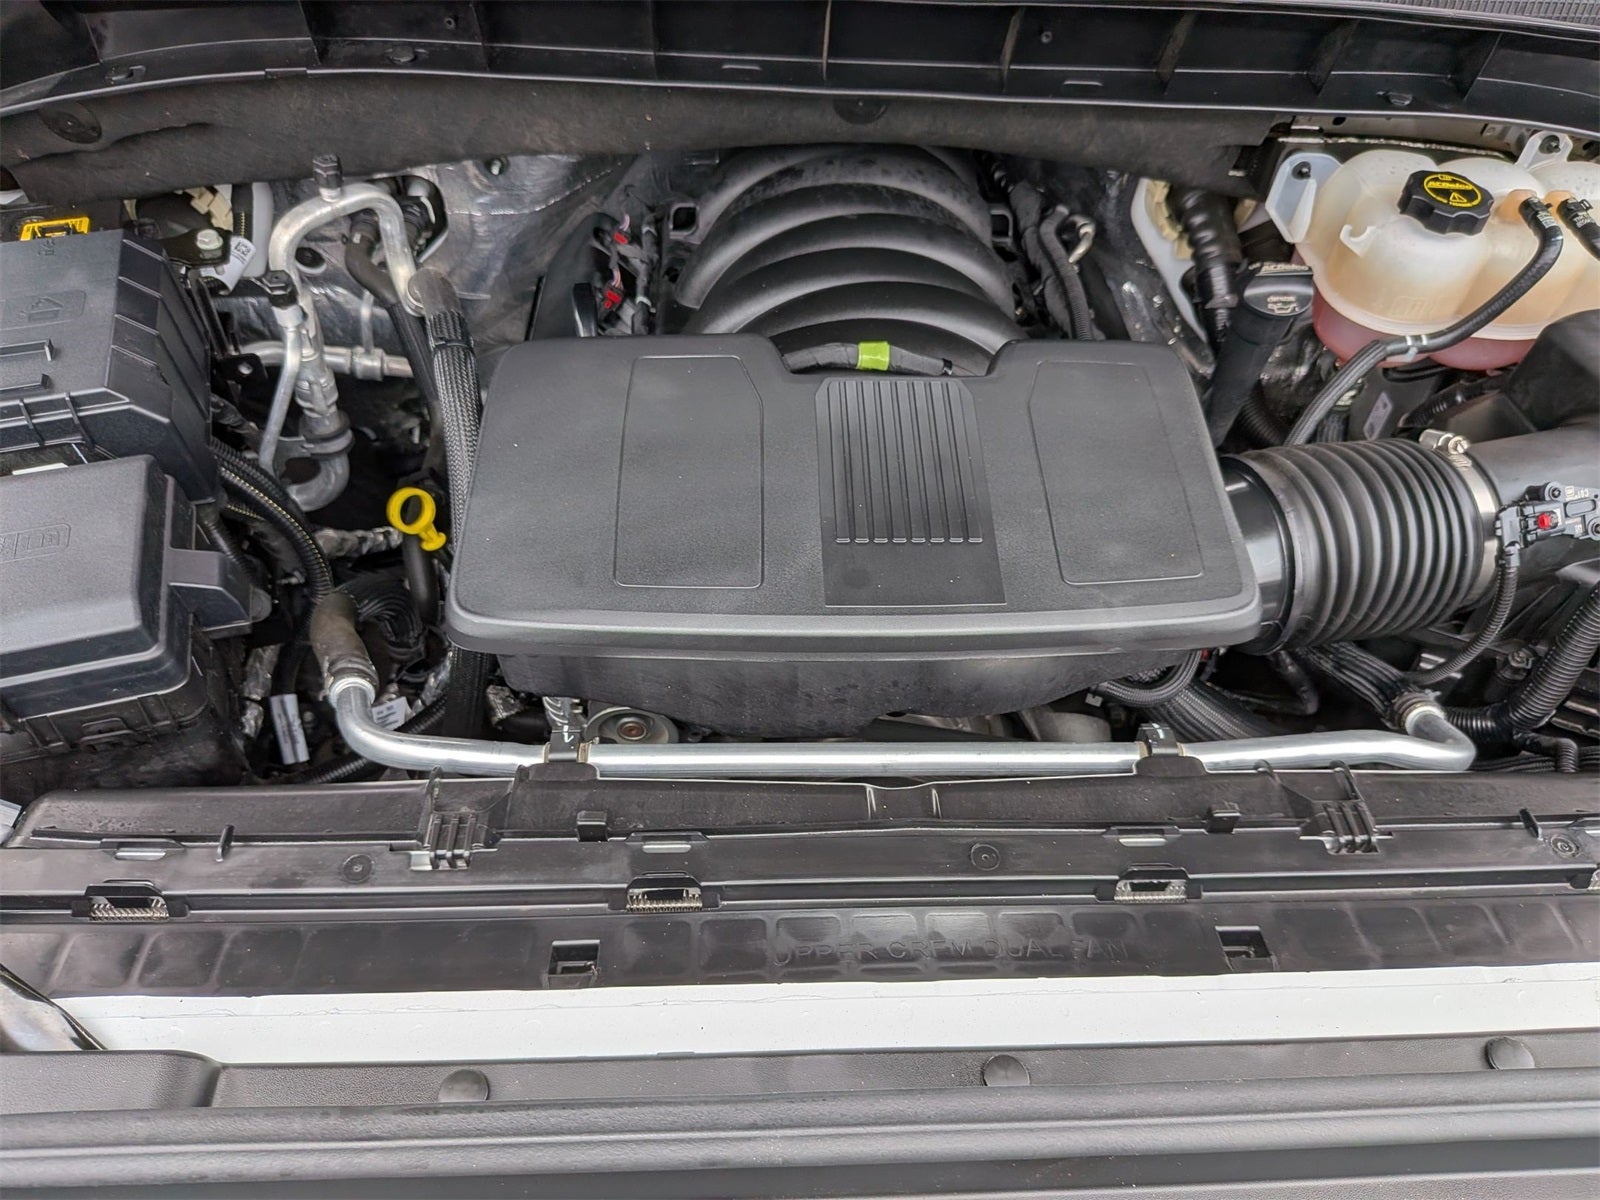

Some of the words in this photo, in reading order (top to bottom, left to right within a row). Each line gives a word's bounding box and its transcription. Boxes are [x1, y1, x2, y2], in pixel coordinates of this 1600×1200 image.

[773, 942, 879, 966] UPPER
[983, 937, 1064, 959] DUAL
[1071, 938, 1129, 960] FAN
